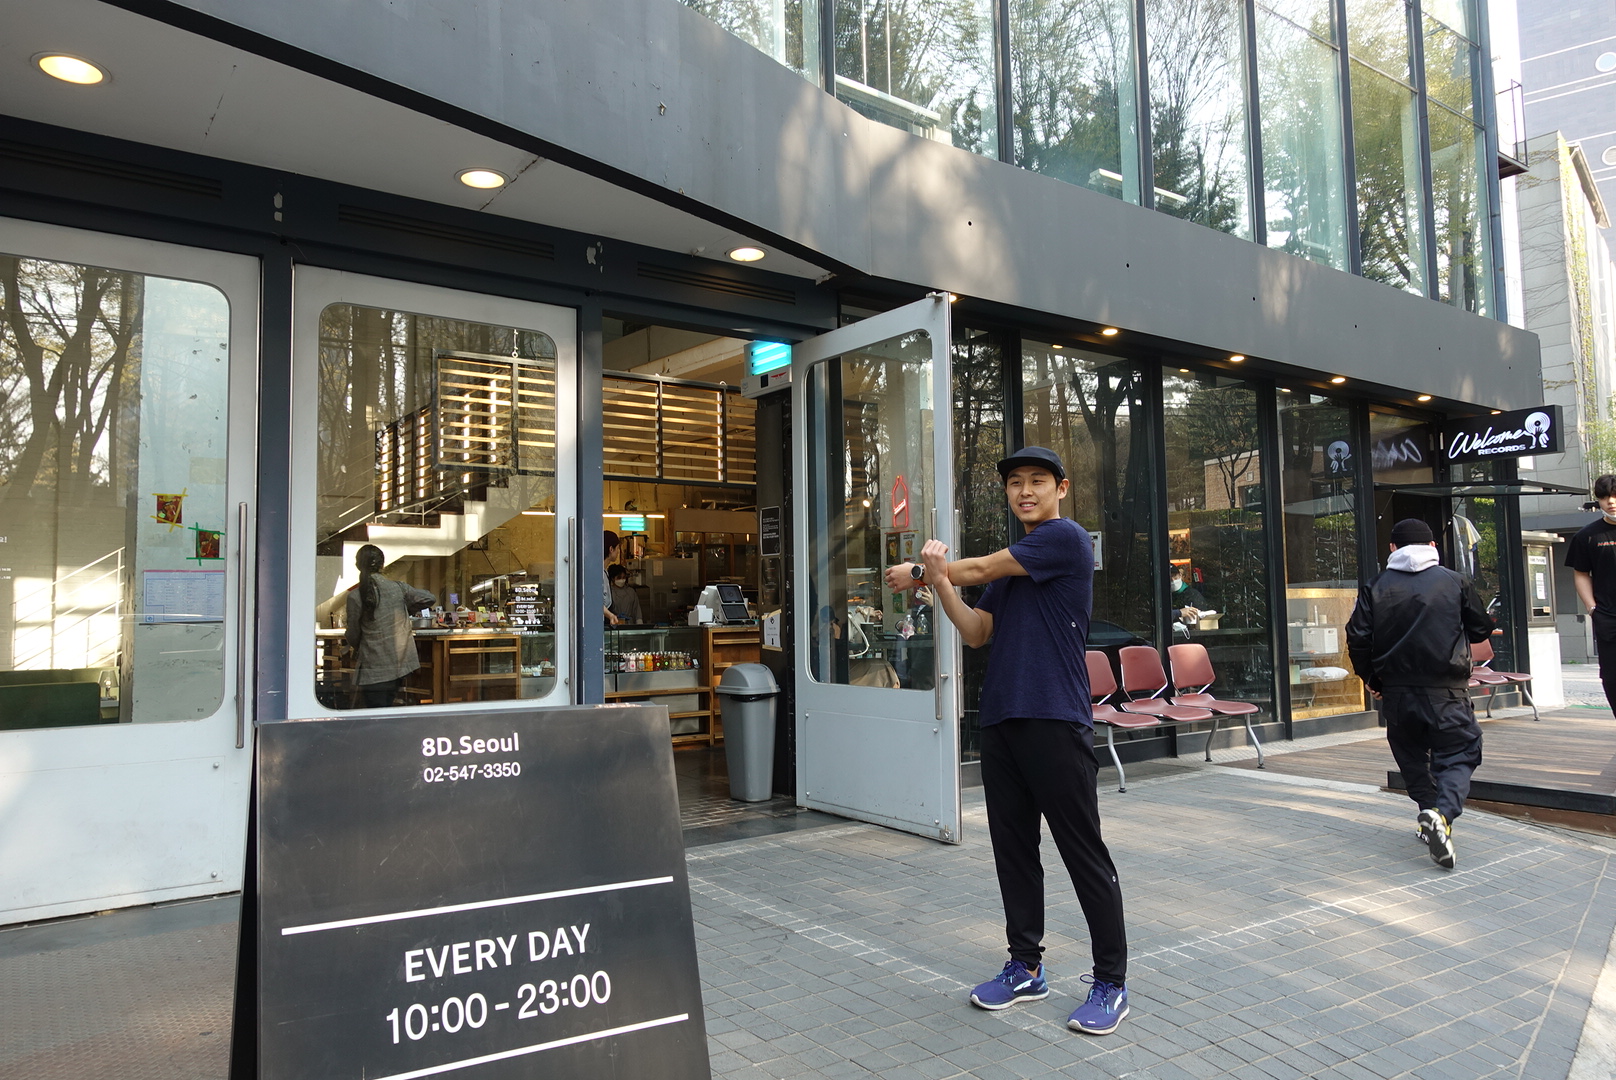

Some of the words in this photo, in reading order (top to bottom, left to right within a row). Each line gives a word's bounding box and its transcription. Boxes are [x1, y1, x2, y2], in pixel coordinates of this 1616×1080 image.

[1448, 426, 1525, 459] Welcome
[1477, 444, 1526, 456] RECORDS
[423, 761, 521, 783] 02-547-3350
[405, 934, 518, 983] EVERY
[528, 923, 591, 962] DAY
[386, 992, 488, 1044] 10:00
[494, 1001, 510, 1011] -
[517, 970, 612, 1020] 23:00
